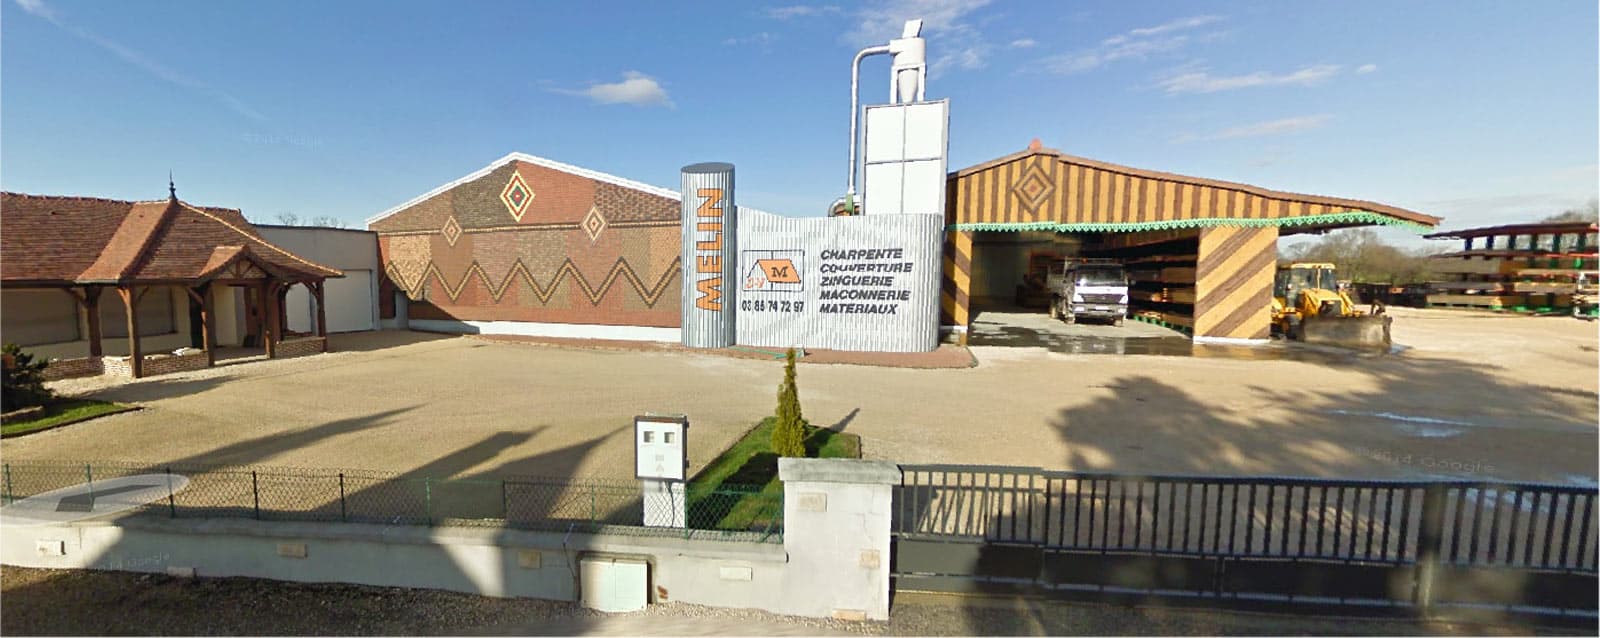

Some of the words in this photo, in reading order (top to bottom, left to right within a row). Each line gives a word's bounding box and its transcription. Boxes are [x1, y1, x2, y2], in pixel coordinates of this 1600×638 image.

[696, 188, 724, 312] MELIN
[820, 248, 903, 260] CHARPENTE
[771, 266, 788, 278] M
[819, 262, 914, 273] COUVERTURE
[820, 275, 894, 287] ZINGUERIE
[819, 289, 911, 301] MACONNERIE
[742, 300, 751, 311] 03
[781, 300, 791, 312] 72
[794, 300, 804, 312] 97
[819, 303, 898, 314] MATERIAUX
